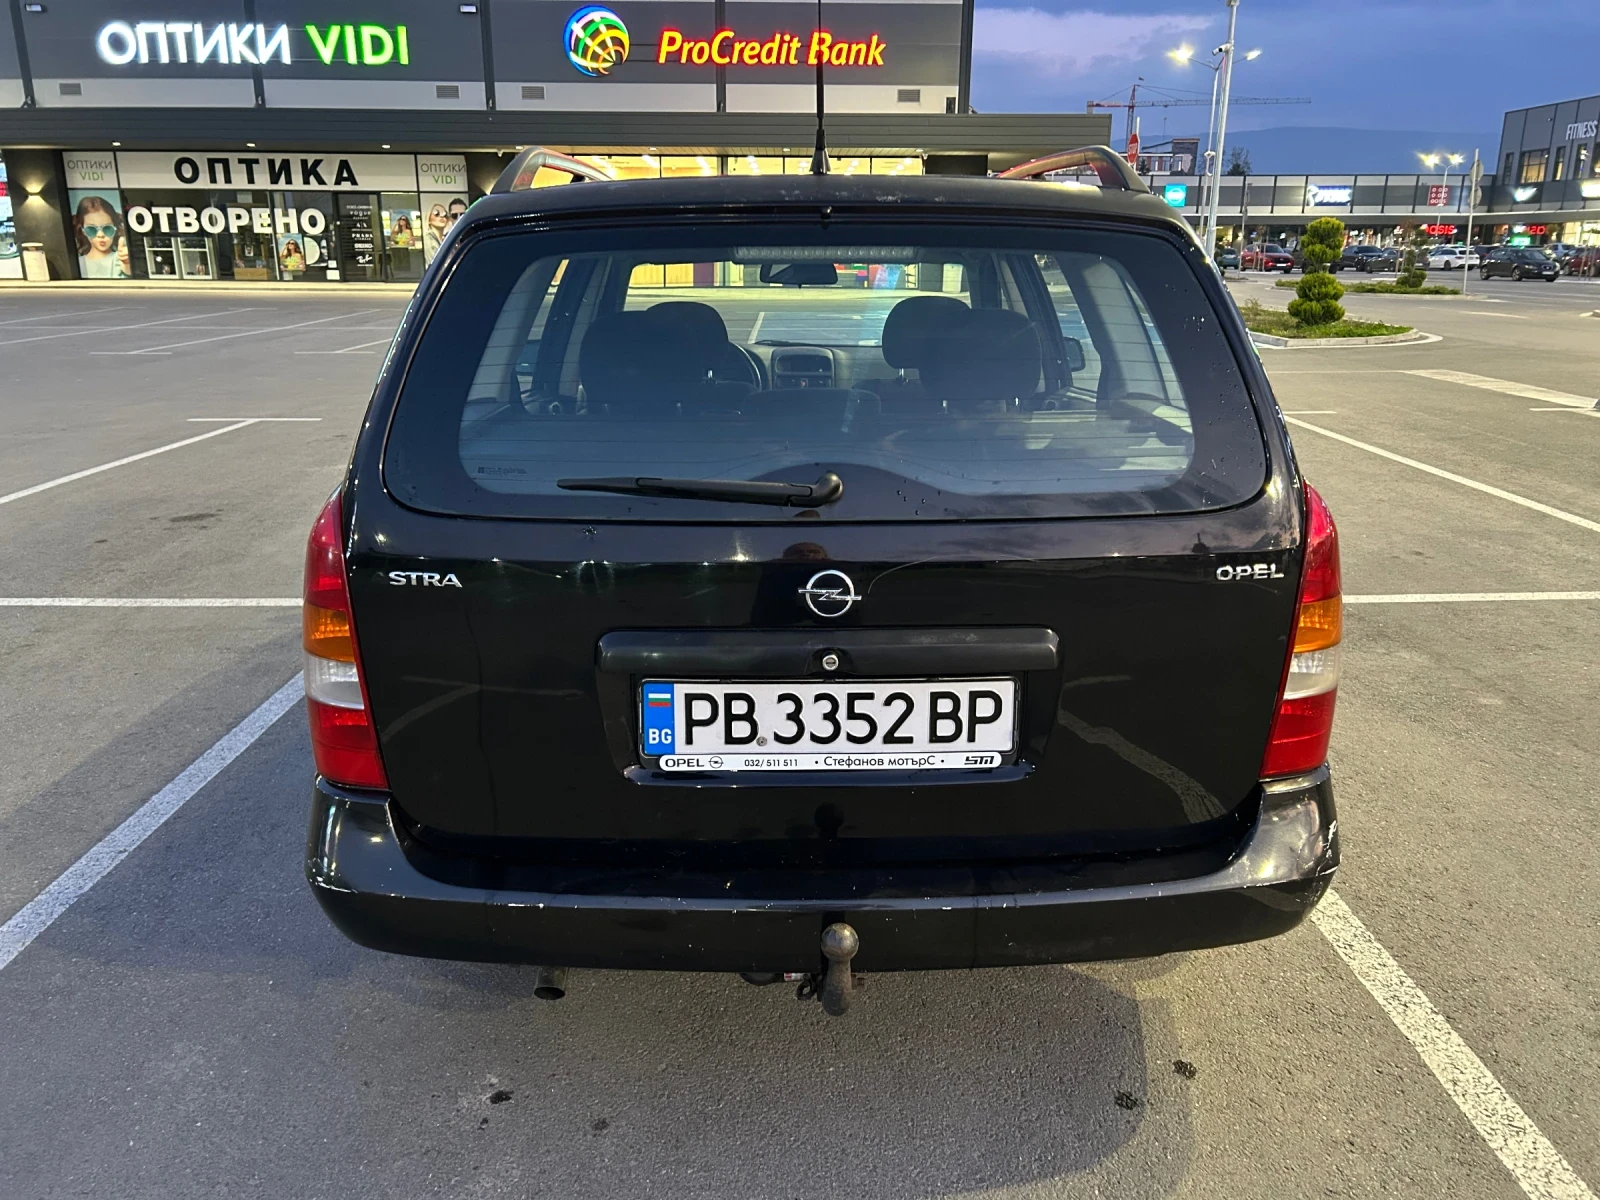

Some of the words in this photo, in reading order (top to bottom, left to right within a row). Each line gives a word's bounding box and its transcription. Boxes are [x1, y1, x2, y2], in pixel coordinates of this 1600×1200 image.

[98, 21, 292, 66] ОПТИКИ
[305, 24, 409, 66] VIDI
[658, 29, 801, 65] ProCredit
[807, 31, 886, 66] Bank
[1565, 119, 1598, 140] FITNESS
[67, 159, 113, 170] ОПТИКИ
[174, 156, 359, 186] ОПТИКА
[420, 163, 466, 173] ОПТИКИ
[80, 172, 104, 181] VIDI
[432, 175, 457, 184] VIDI
[127, 206, 326, 236] ОТВОРЕНО
[388, 571, 463, 588] STRA
[1216, 563, 1285, 581] OPEL
[683, 691, 759, 745] PB
[773, 690, 915, 745] 3352
[928, 690, 1003, 744] BP
[648, 728, 672, 745] BG
[664, 758, 705, 768] OPEL
[766, 758, 780, 767] 511
[783, 758, 798, 767] 511
[823, 755, 884, 768] Стефанов
